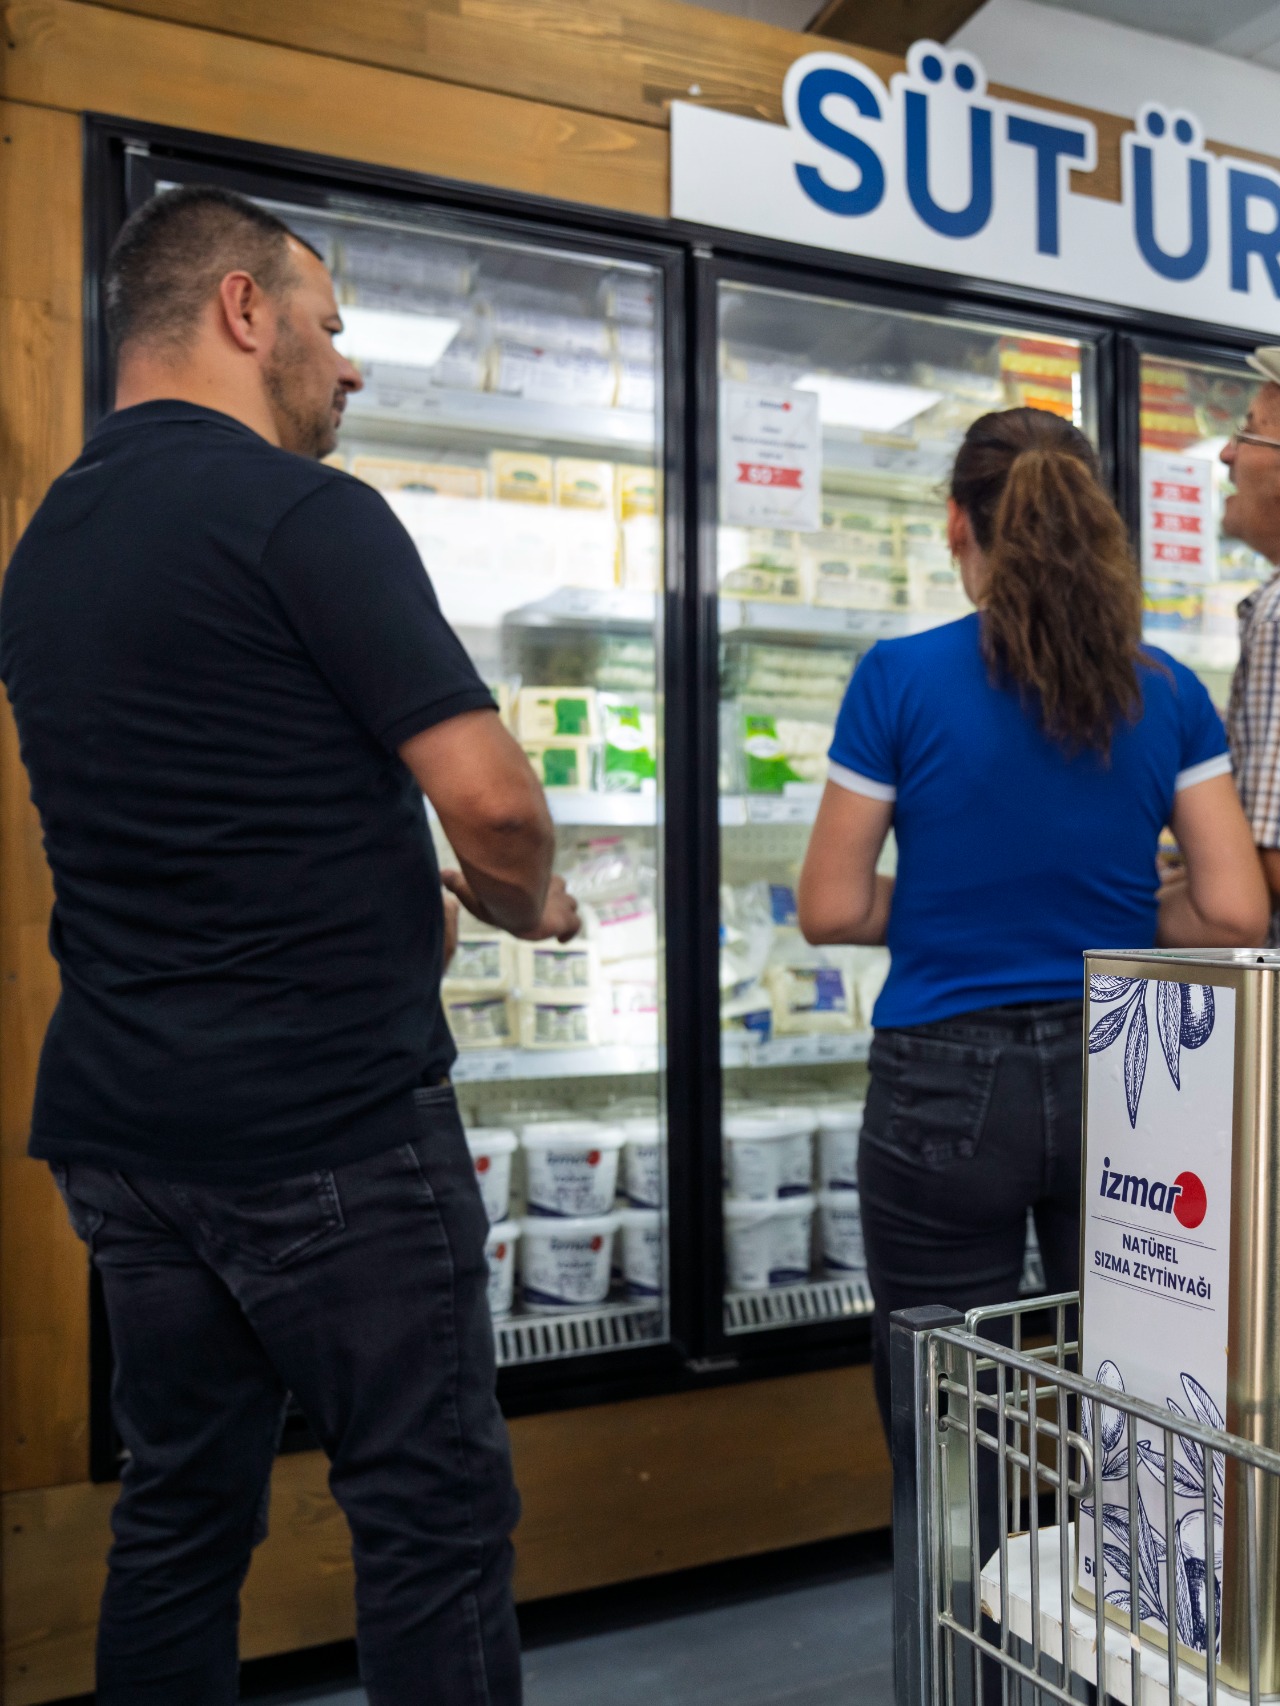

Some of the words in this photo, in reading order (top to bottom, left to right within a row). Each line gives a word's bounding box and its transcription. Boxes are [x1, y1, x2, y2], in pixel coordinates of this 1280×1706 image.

[794, 54, 1086, 256] SÜT
[1100, 1156, 1181, 1214] izmar
[1094, 1250, 1130, 1277] SIZMA
[1133, 1263, 1211, 1300] ZEYTİNYAĞI
[1122, 1233, 1178, 1265] NATÜREL
